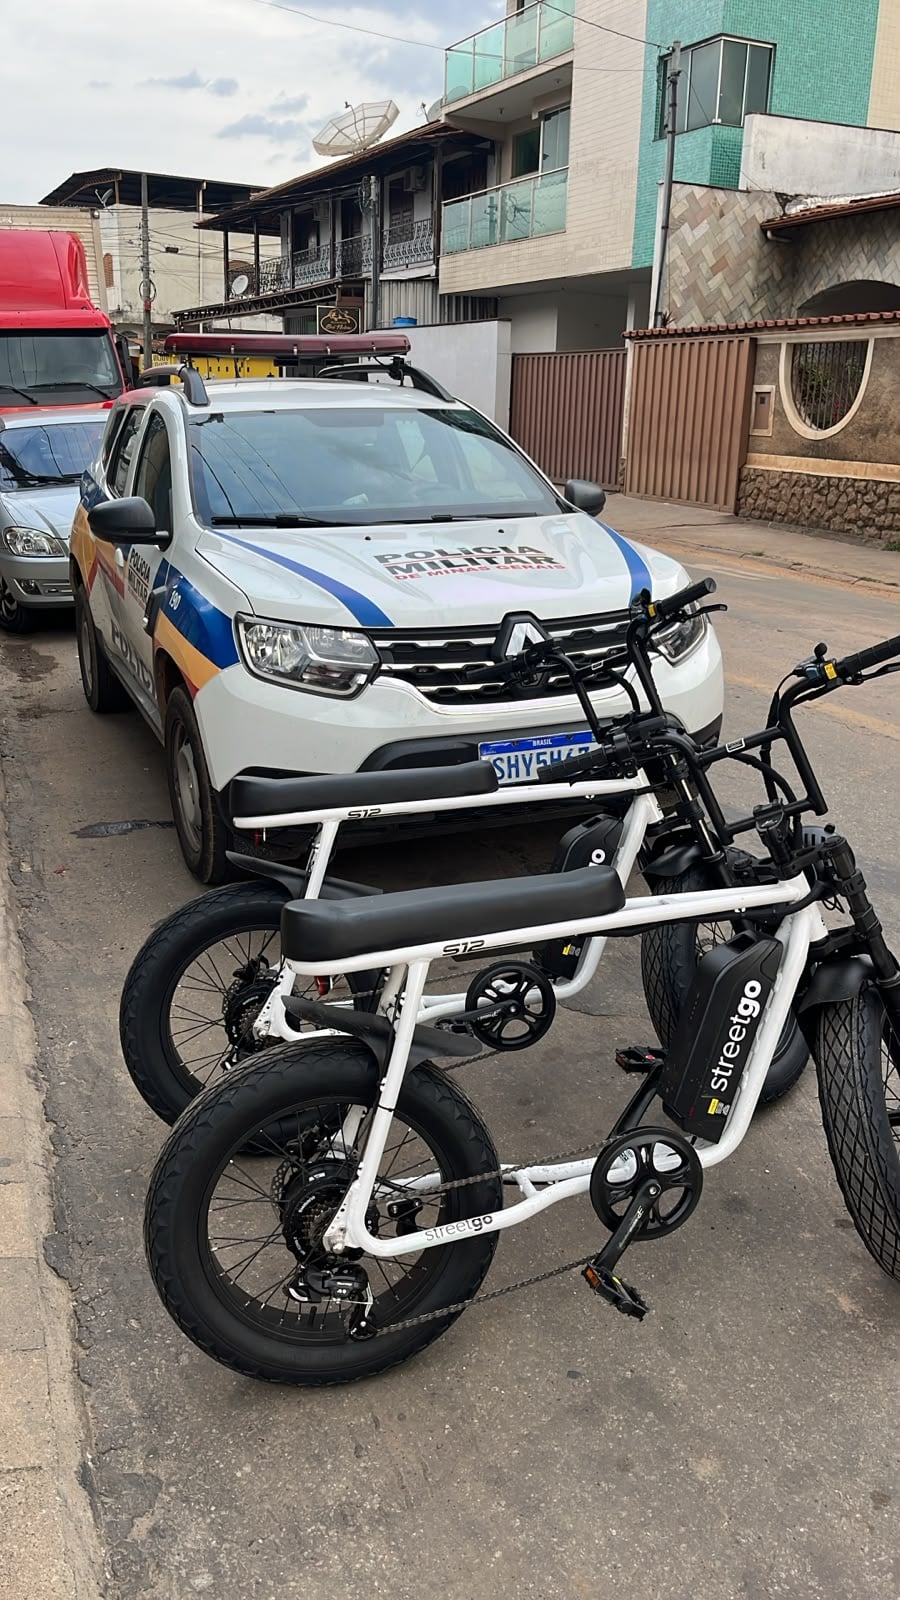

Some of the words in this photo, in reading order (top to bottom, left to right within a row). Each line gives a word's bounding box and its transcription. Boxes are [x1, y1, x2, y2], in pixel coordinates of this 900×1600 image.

[385, 555, 561, 575] MILITAR
[427, 565, 490, 577] MINAS
[496, 563, 566, 571] GERAIS
[532, 738, 553, 747] BRASIL
[347, 808, 382, 819] S12
[442, 939, 485, 957] S12
[710, 979, 762, 1093] streetgo
[425, 1215, 493, 1241] streetgo
